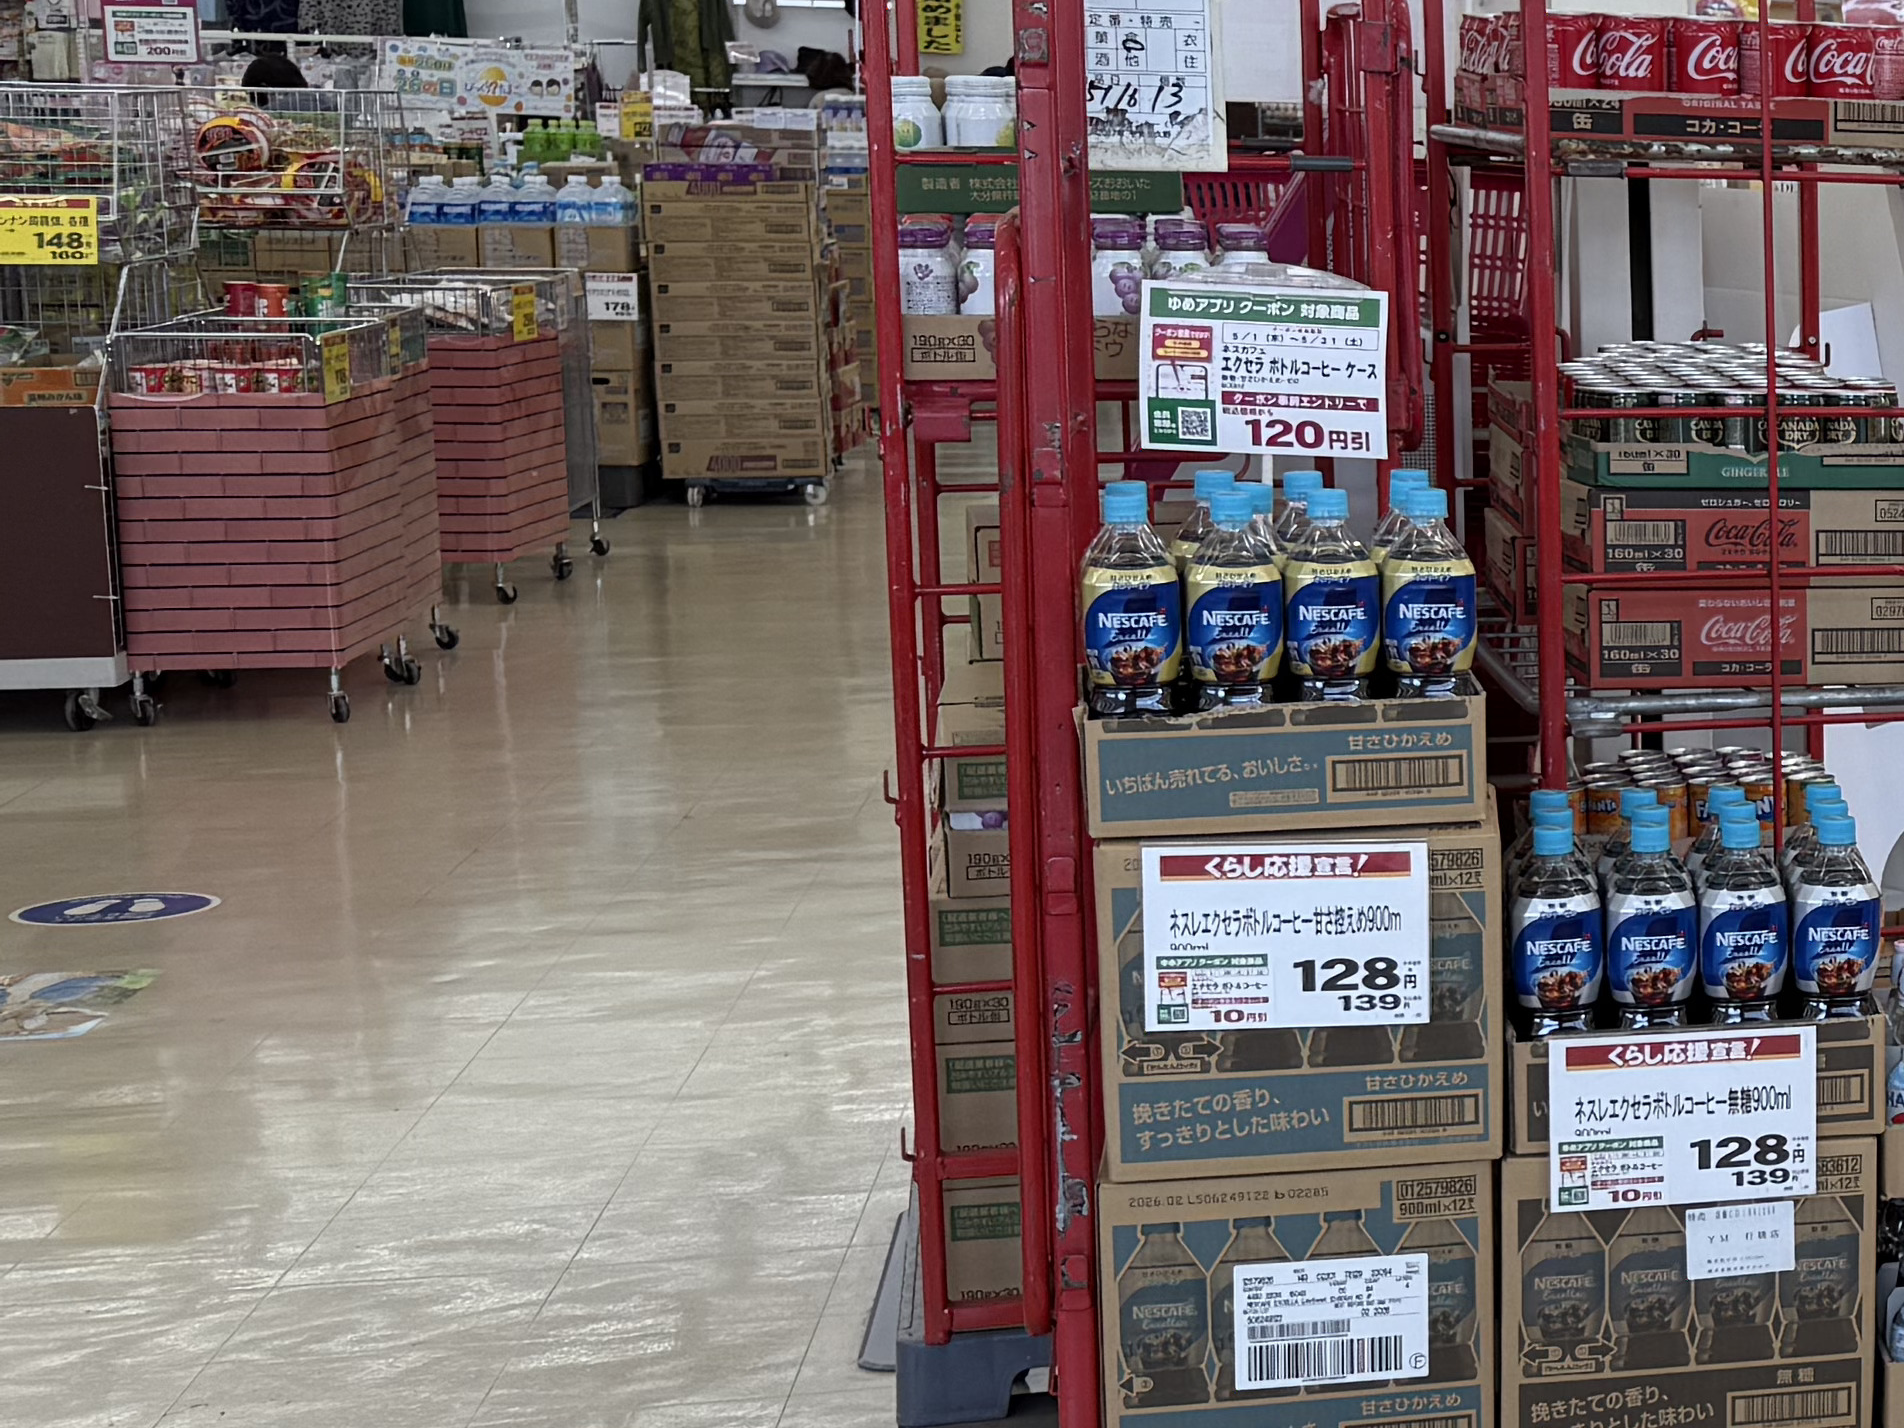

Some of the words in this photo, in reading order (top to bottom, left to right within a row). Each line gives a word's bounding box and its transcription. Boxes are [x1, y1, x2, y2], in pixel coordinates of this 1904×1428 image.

[1167, 298, 1235, 315] ゆめアプリ
[1239, 301, 1295, 316] クーポン
[1221, 356, 1264, 374] エクセラ
[1270, 358, 1340, 376] ボトルコーヒー
[1345, 362, 1377, 379] ケース
[1245, 419, 1371, 451] 120円引
[1365, 1073, 1468, 1091] 甘さひかえめ
[1361, 1394, 1461, 1416] 甘さひかえめ
